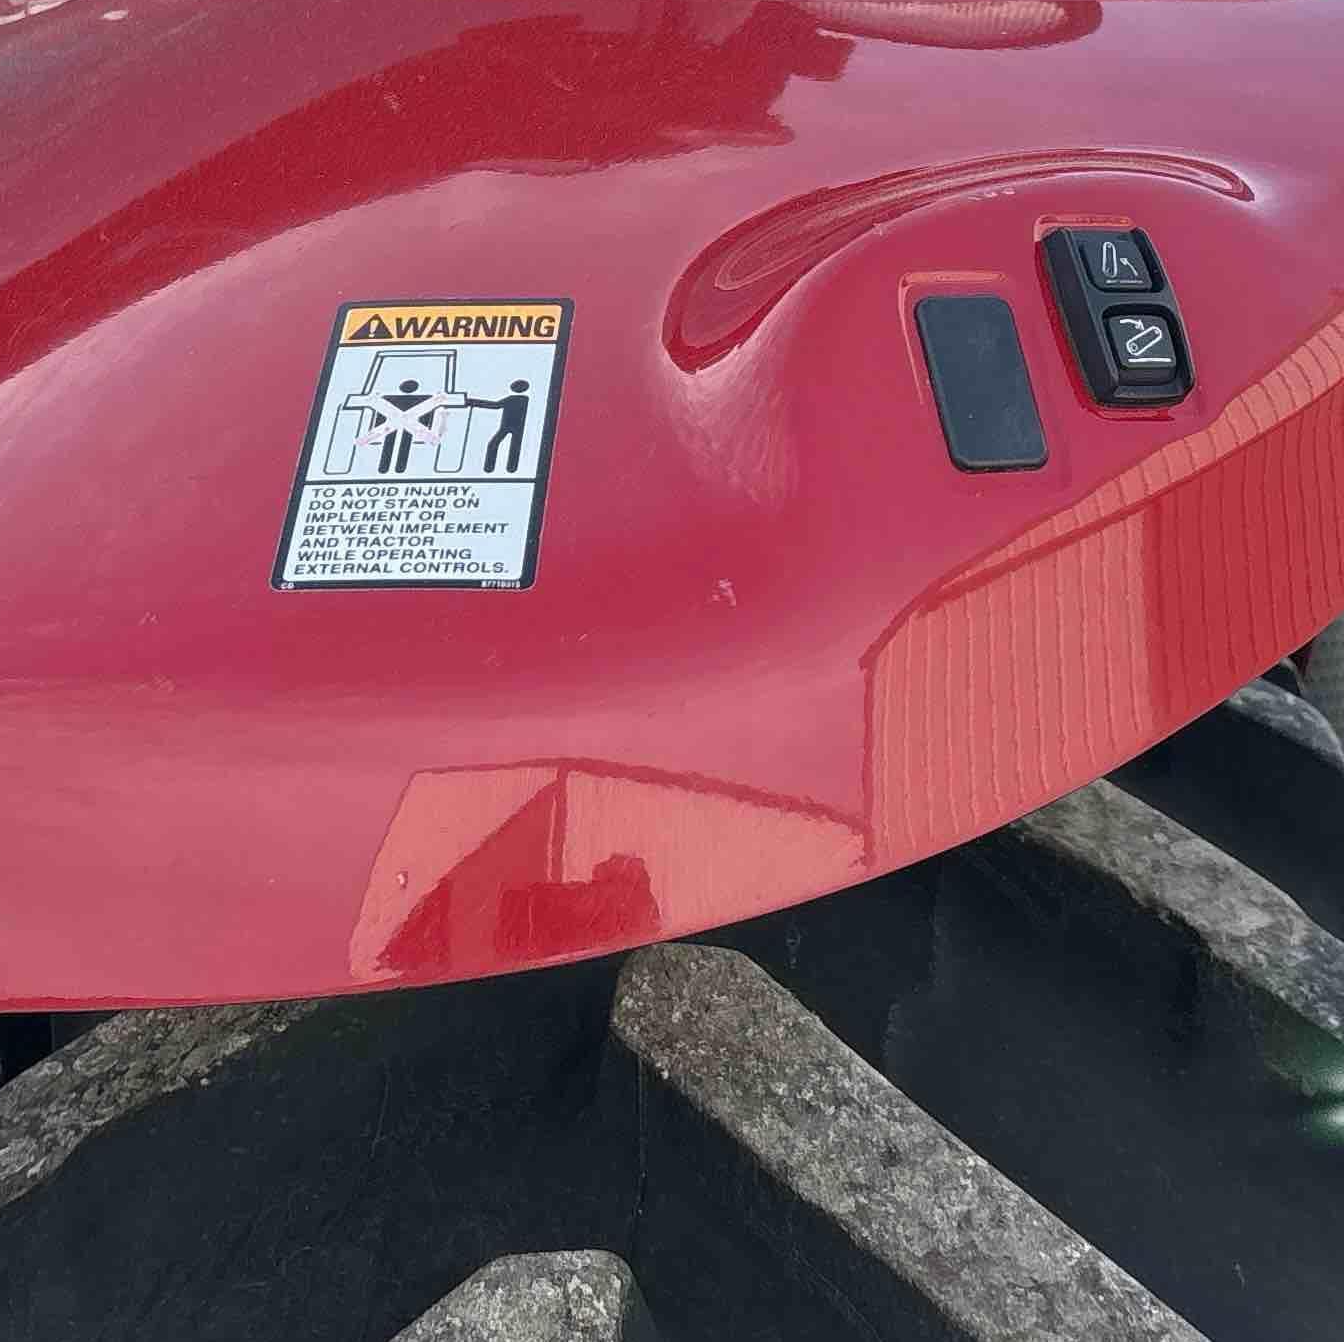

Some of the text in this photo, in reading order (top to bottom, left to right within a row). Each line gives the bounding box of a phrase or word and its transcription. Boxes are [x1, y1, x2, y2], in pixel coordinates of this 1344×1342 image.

[394, 315, 556, 339] WARNING
[312, 486, 476, 498] TO AVOID INJURY,
[309, 498, 480, 510] DO NOT STAND ON
[305, 511, 446, 523] IMPLEMENT OR
[303, 523, 509, 536] BETWEEN IMPLEMENT
[299, 536, 435, 548] AND TRACTOR
[297, 549, 472, 561] WHILE OPERATING
[294, 562, 509, 575] EXTERNAL CONTROLS.
